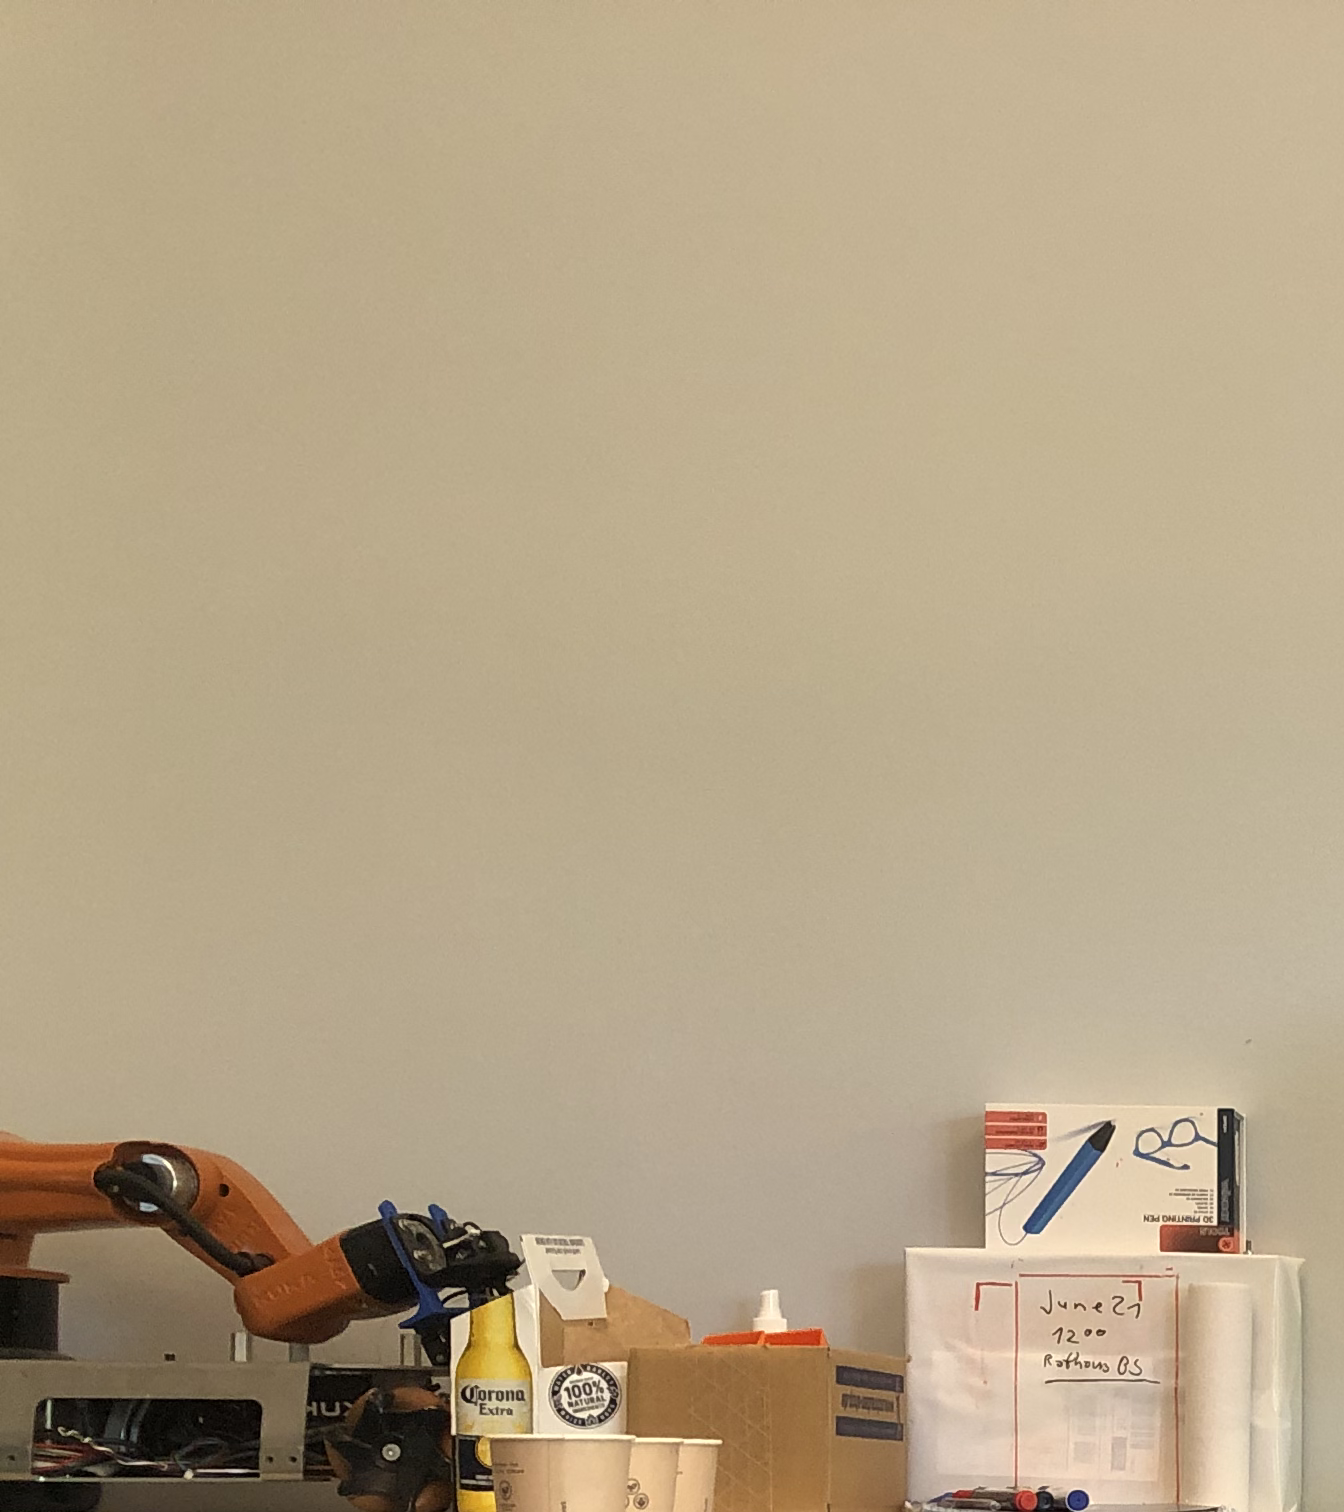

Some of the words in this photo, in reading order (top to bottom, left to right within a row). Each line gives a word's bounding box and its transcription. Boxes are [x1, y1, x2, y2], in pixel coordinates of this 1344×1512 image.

[1143, 1214, 1160, 1223] PEN
[1162, 1215, 1201, 1223] PRINTING
[1203, 1215, 1214, 1223] 3D
[1039, 1289, 1103, 1315] June
[1111, 1295, 1141, 1319] 21
[460, 1384, 526, 1407] Corona
[563, 1379, 605, 1400] 100%
[567, 1395, 607, 1408] NATURAL
[478, 1403, 514, 1416] Extra
